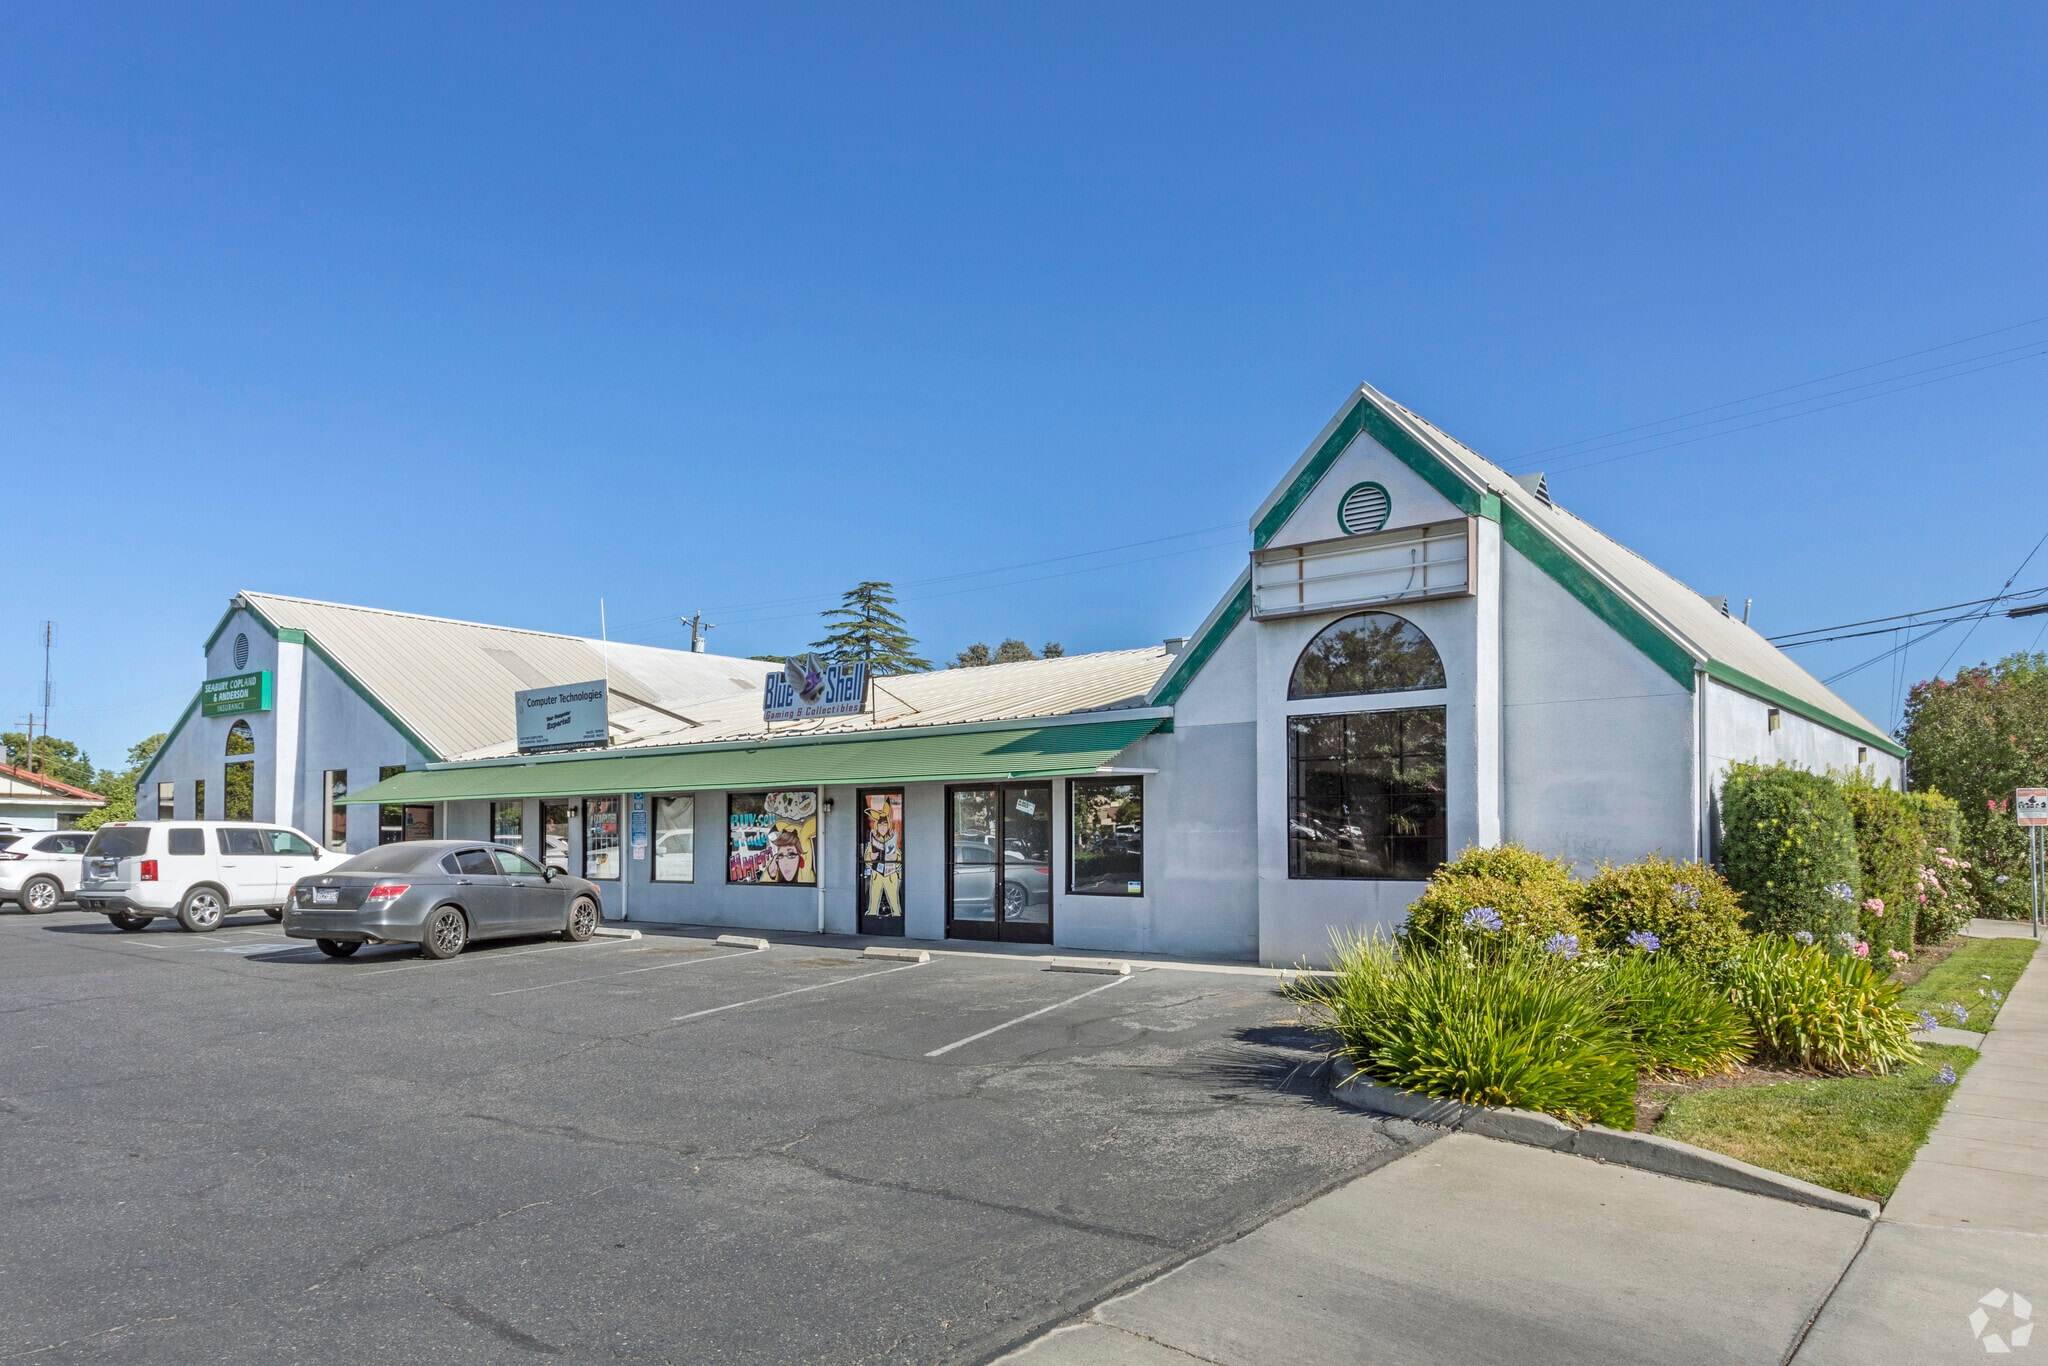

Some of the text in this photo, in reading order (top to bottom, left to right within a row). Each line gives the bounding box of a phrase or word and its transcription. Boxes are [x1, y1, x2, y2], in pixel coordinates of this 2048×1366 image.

[229, 676, 257, 689] COPLAND
[764, 663, 864, 709] Blue Shell
[218, 689, 249, 701] ANDERSON
[526, 689, 603, 709] Computer Technologies
[217, 702, 245, 712] INSURANCE
[765, 703, 859, 720] Gaming & Collectibles
